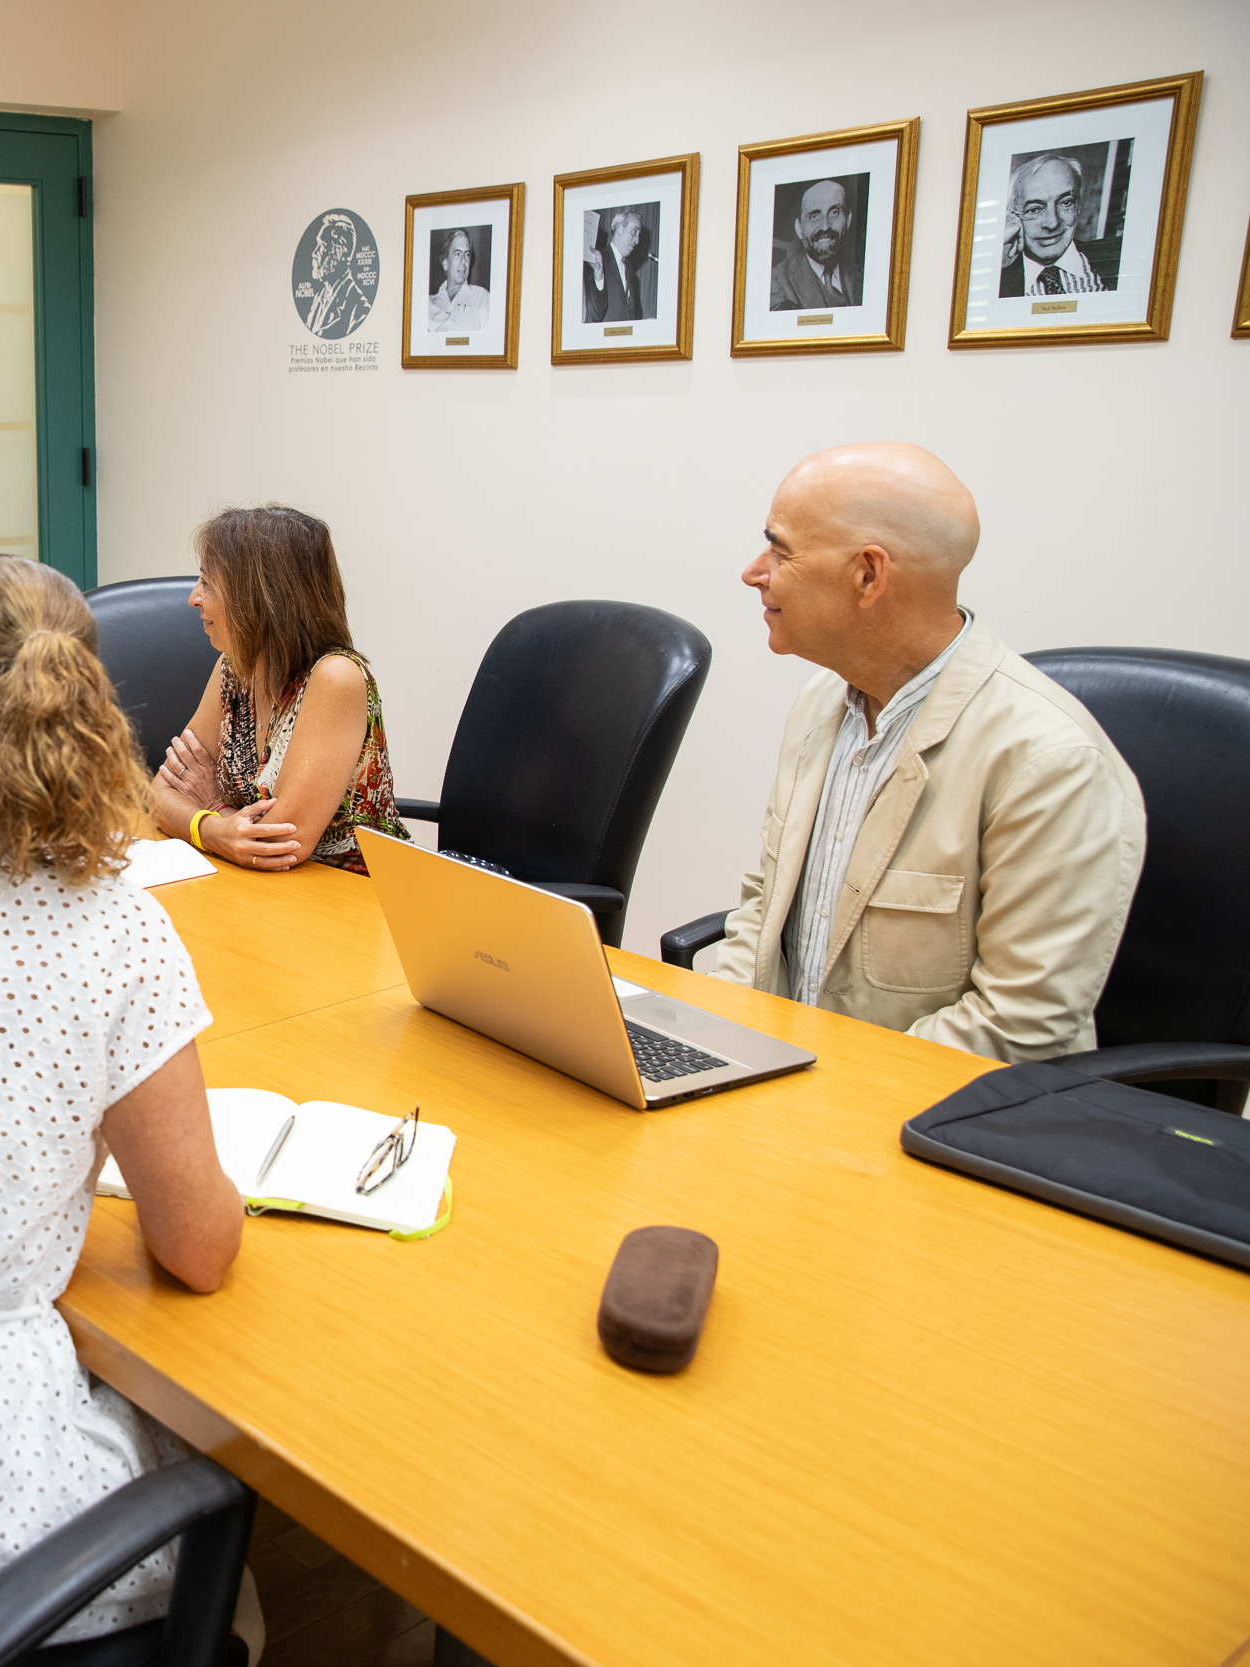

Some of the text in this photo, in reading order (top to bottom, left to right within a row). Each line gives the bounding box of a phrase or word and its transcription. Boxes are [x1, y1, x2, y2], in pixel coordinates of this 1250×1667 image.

[356, 251, 376, 259] MDCCC
[295, 288, 315, 298] NOBEL
[289, 342, 379, 356] THE NOBEL PRIZE
[315, 356, 334, 364] Nobel
[335, 357, 347, 365] que
[363, 355, 377, 363] sido
[289, 365, 319, 373] profesores
[355, 363, 379, 371] Recinto
[474, 949, 511, 973] ASUS
